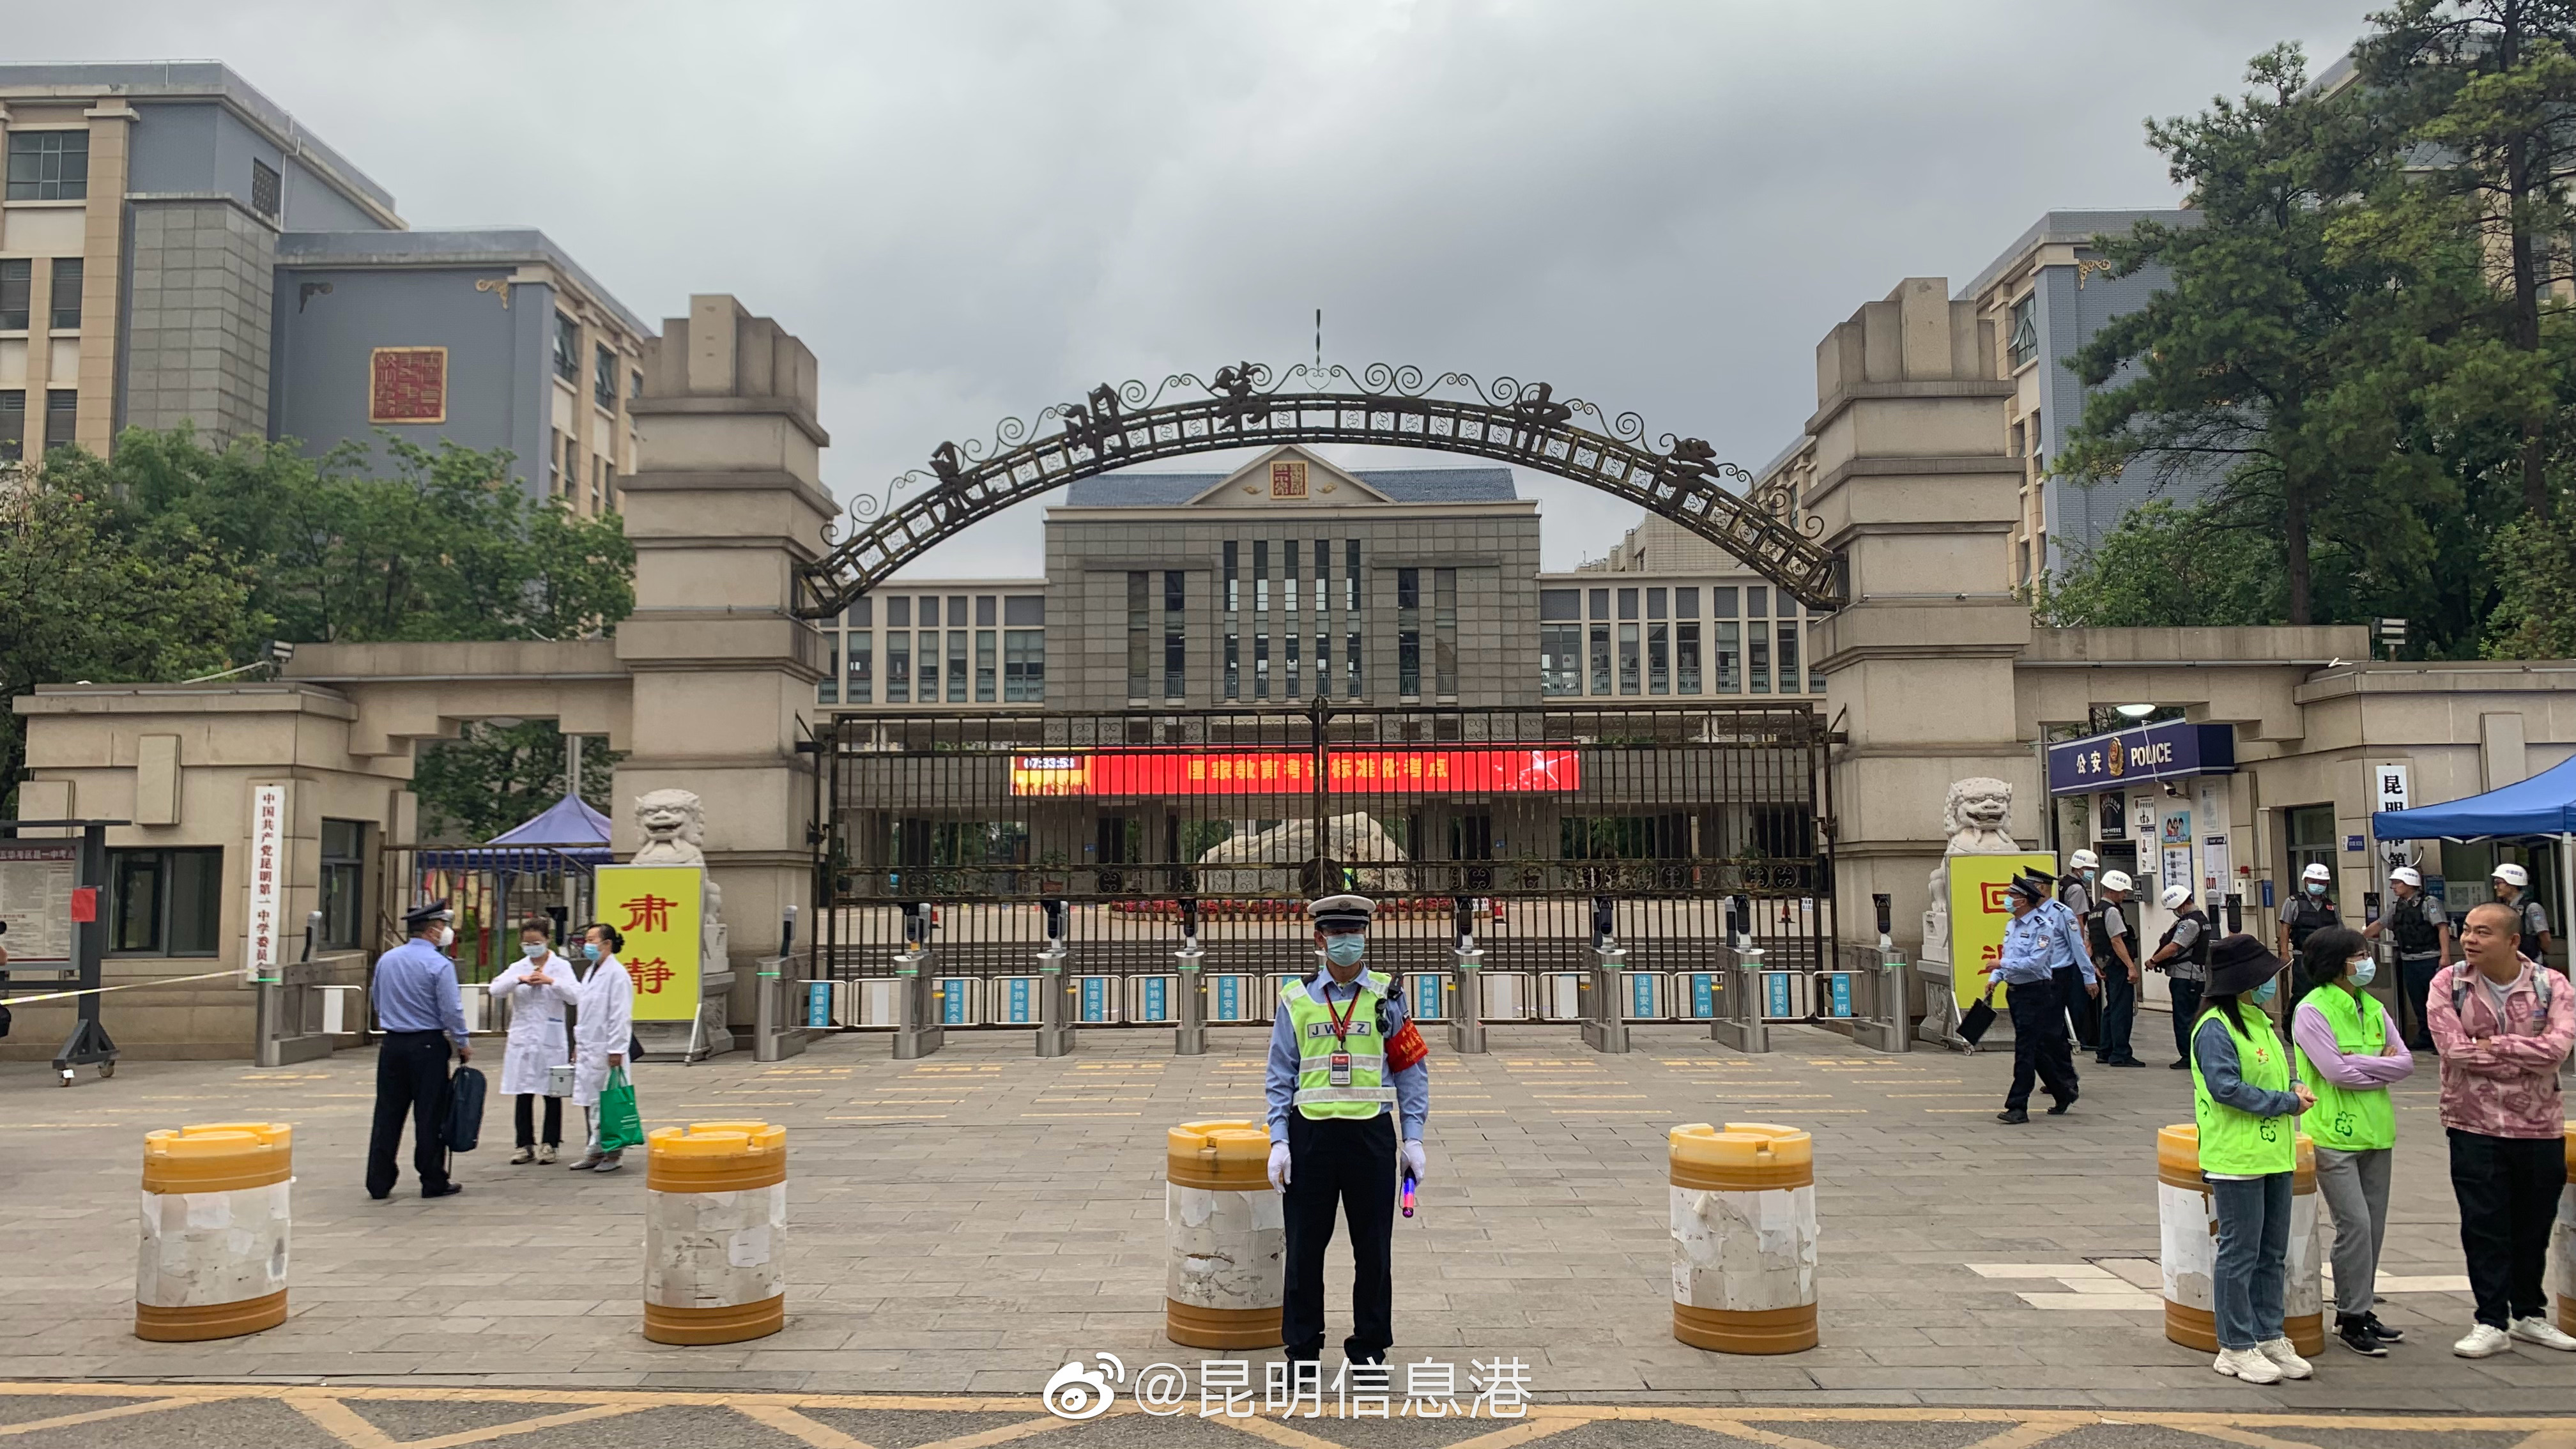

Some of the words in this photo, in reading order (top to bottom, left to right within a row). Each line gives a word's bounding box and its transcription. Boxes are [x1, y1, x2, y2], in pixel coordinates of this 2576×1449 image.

[2076, 750, 2102, 774] 公安
[2131, 742, 2173, 767] POLICE
[620, 894, 678, 994] 肃静
[814, 985, 824, 1025] 注意安全
[949, 982, 959, 1023] 注意安全
[1089, 980, 1099, 1021] 注意安全
[1223, 978, 1234, 1019] 注意安全
[1638, 976, 1649, 1015] 注意安全
[1697, 977, 1709, 1014] 一车一杆
[1774, 976, 1784, 1015] 注意安全
[1836, 976, 1848, 1013] 一车一杆
